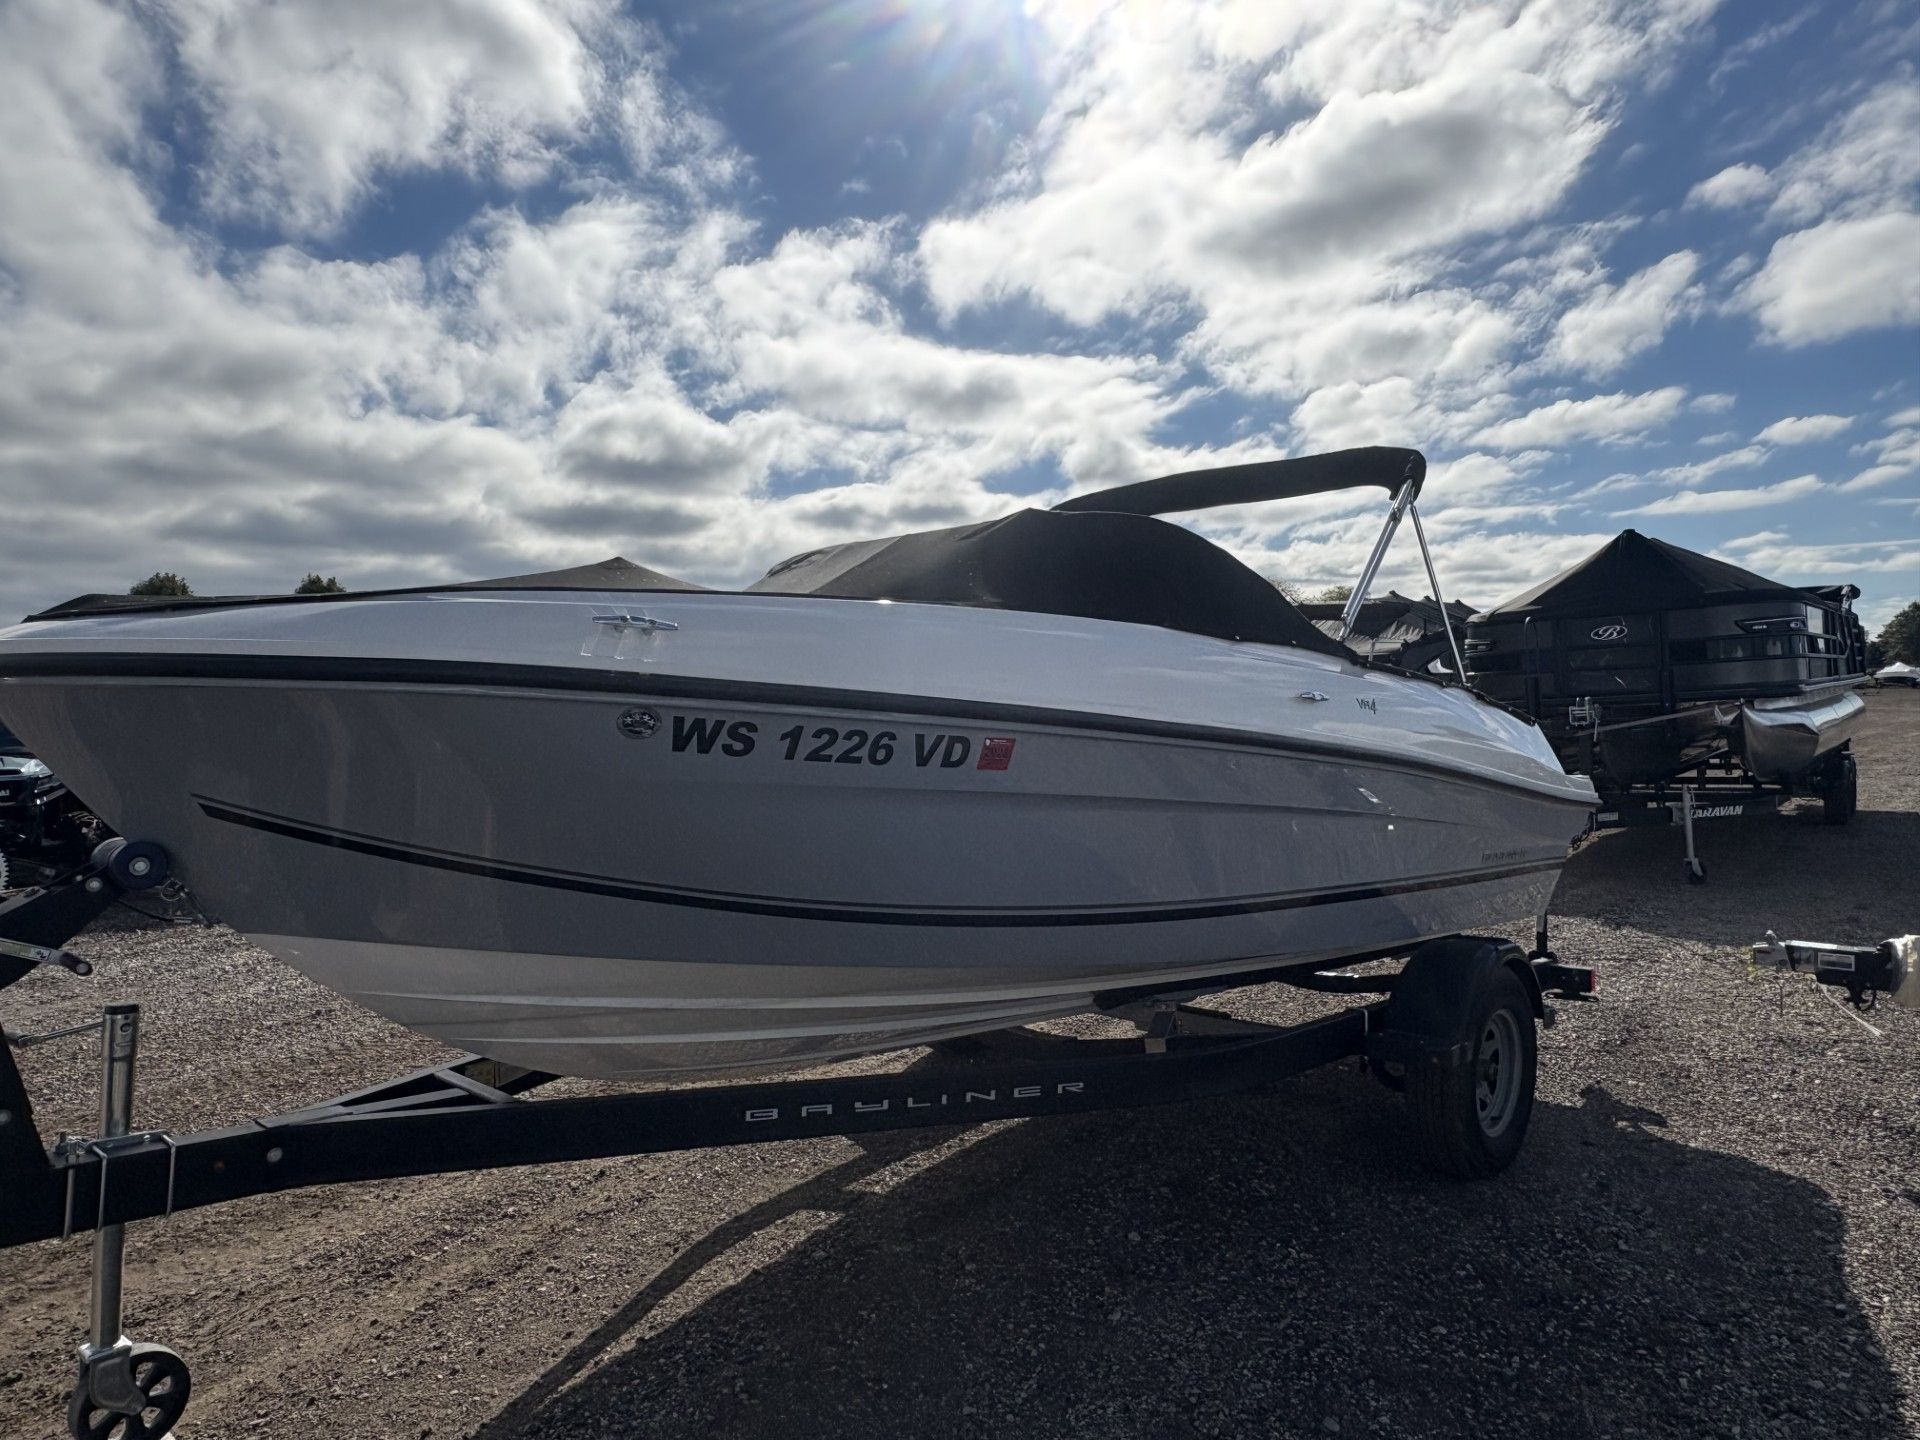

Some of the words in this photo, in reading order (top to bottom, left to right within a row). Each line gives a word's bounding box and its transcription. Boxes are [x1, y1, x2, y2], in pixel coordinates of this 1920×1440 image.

[672, 716, 758, 757] WS
[779, 725, 897, 765] 1226
[915, 734, 971, 768] VD
[745, 1082, 1084, 1122] BAYLINER
